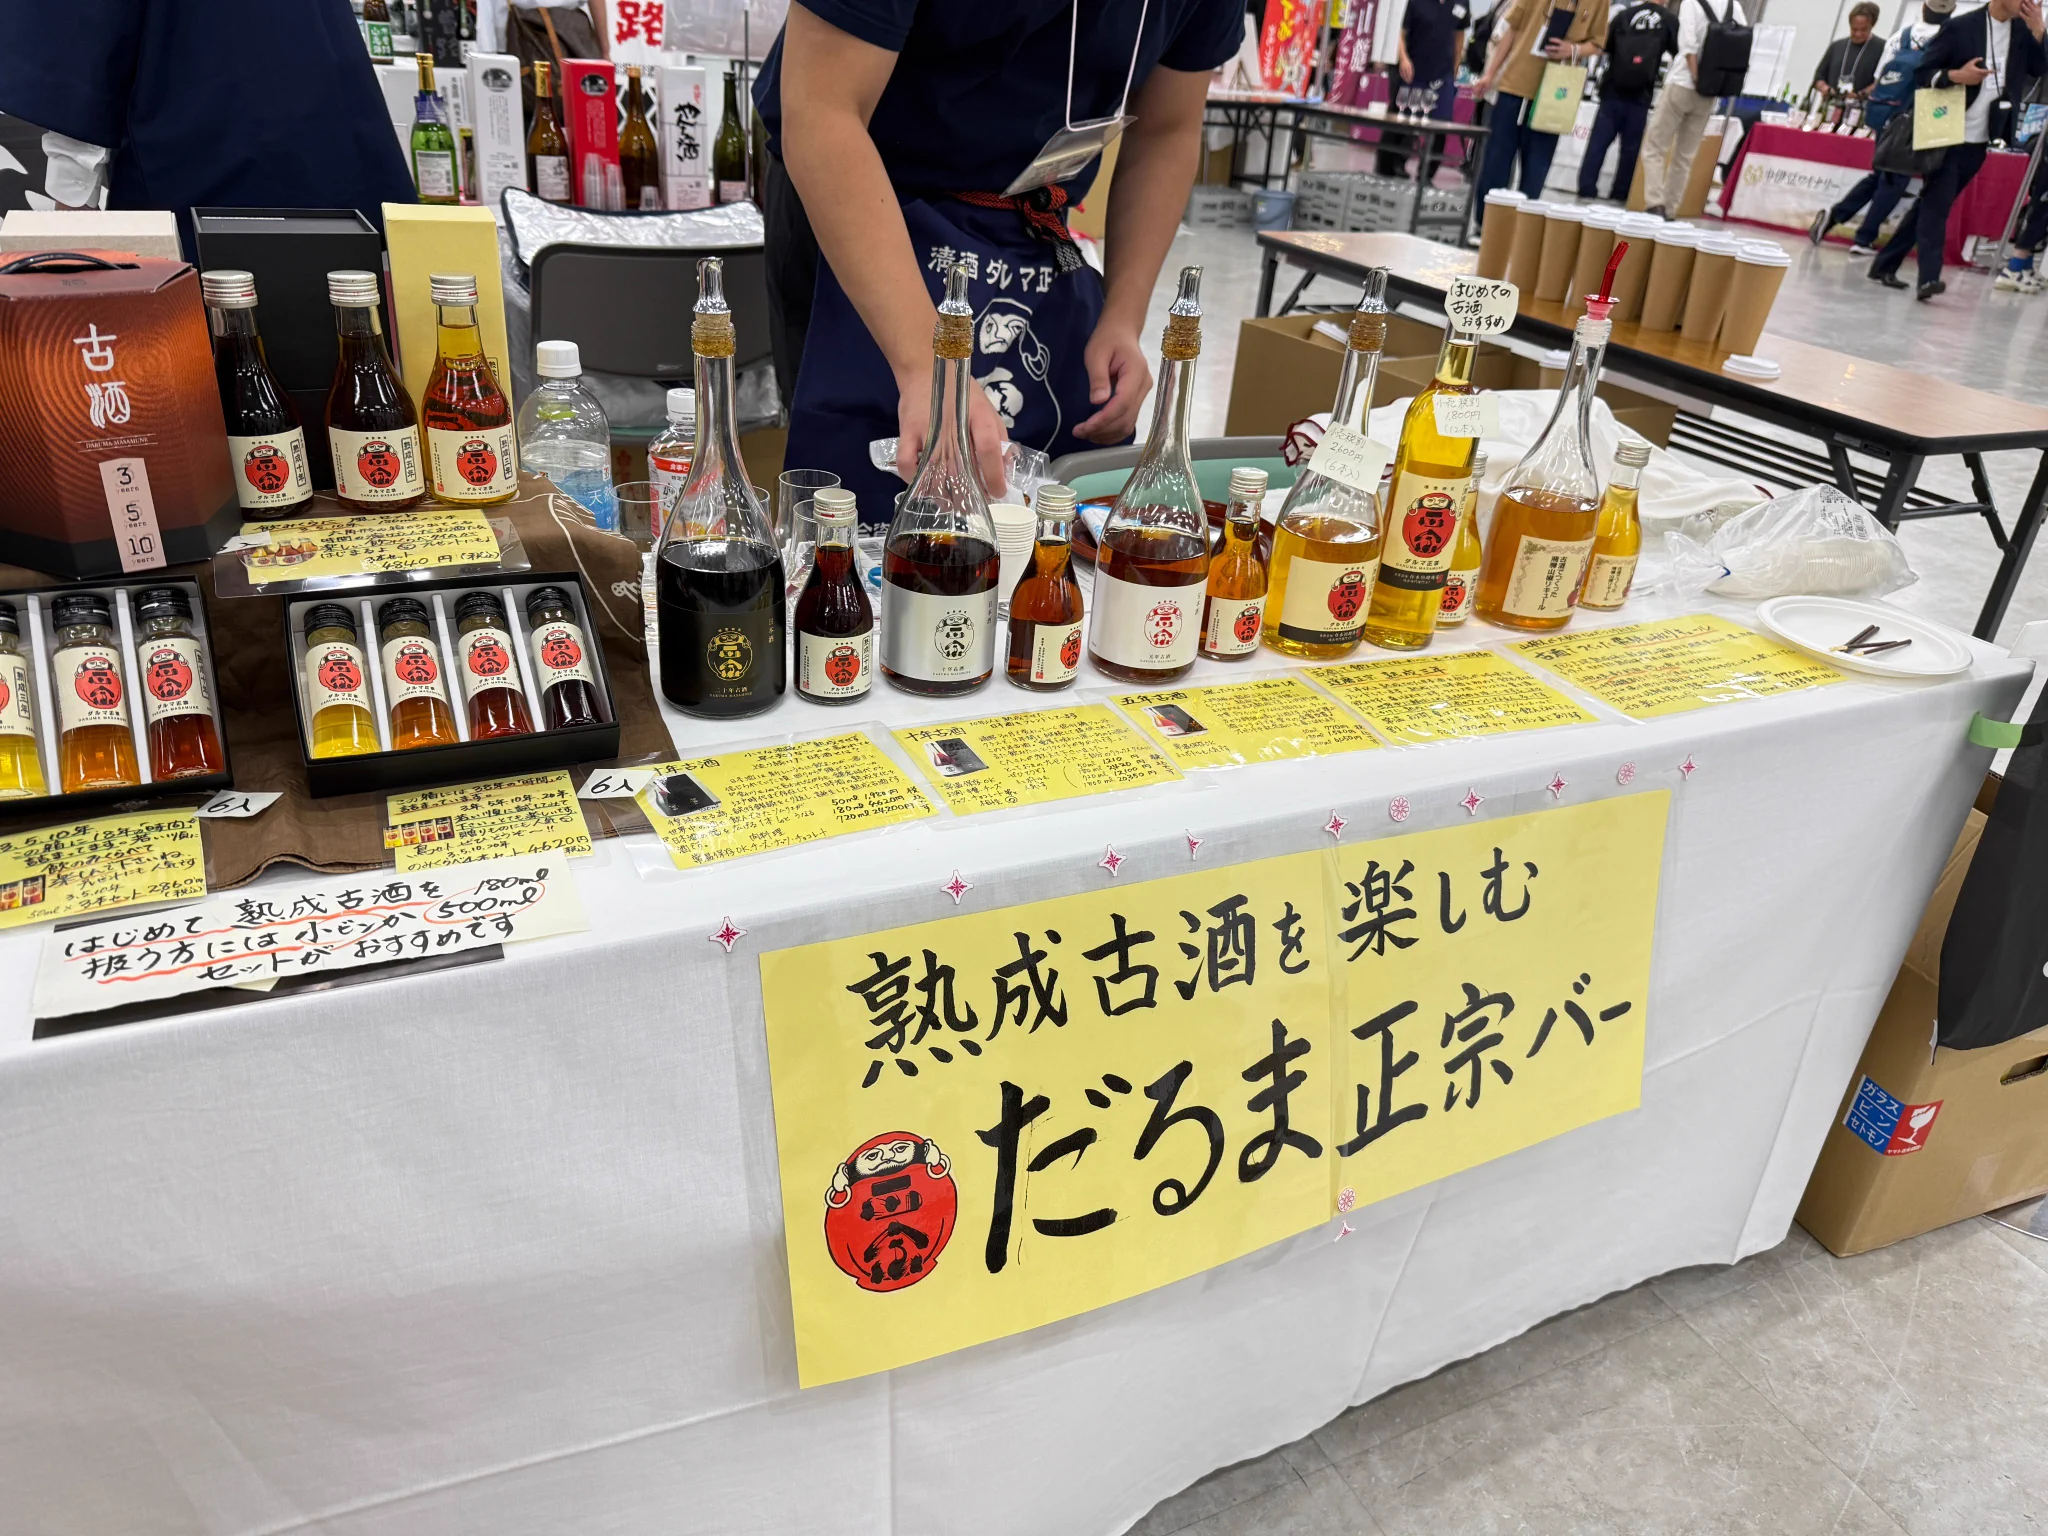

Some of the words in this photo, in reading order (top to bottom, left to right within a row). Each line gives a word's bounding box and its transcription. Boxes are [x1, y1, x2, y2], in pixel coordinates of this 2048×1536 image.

[1451, 283, 1511, 299] はじめての
[1450, 300, 1482, 315] 古酒
[1462, 315, 1505, 330] おすすめ
[73, 322, 131, 428] 古酒
[1445, 411, 1481, 424] 1,800円
[129, 536, 153, 555] 10
[1404, 558, 1439, 567] ダルマ正宗
[16, 671, 29, 717] 熟成三年
[1115, 691, 1190, 706] 五年古酒
[903, 726, 968, 742] 十年古酒
[64, 914, 204, 957] はじめて
[234, 877, 445, 928] 熟成古酒を
[474, 867, 551, 896] 180ml
[80, 931, 280, 982] 扱う方には
[437, 885, 542, 922] 500ml
[197, 944, 338, 982] セットが
[353, 913, 518, 958] おすすめです
[846, 846, 1537, 1089] 熟成古酒を楽しむ
[1863, 1081, 1899, 1115] ガラス
[975, 971, 1633, 1274] だるま正宗バー
[1858, 1100, 1891, 1127] ビン
[1850, 1115, 1885, 1147] セトモノ
